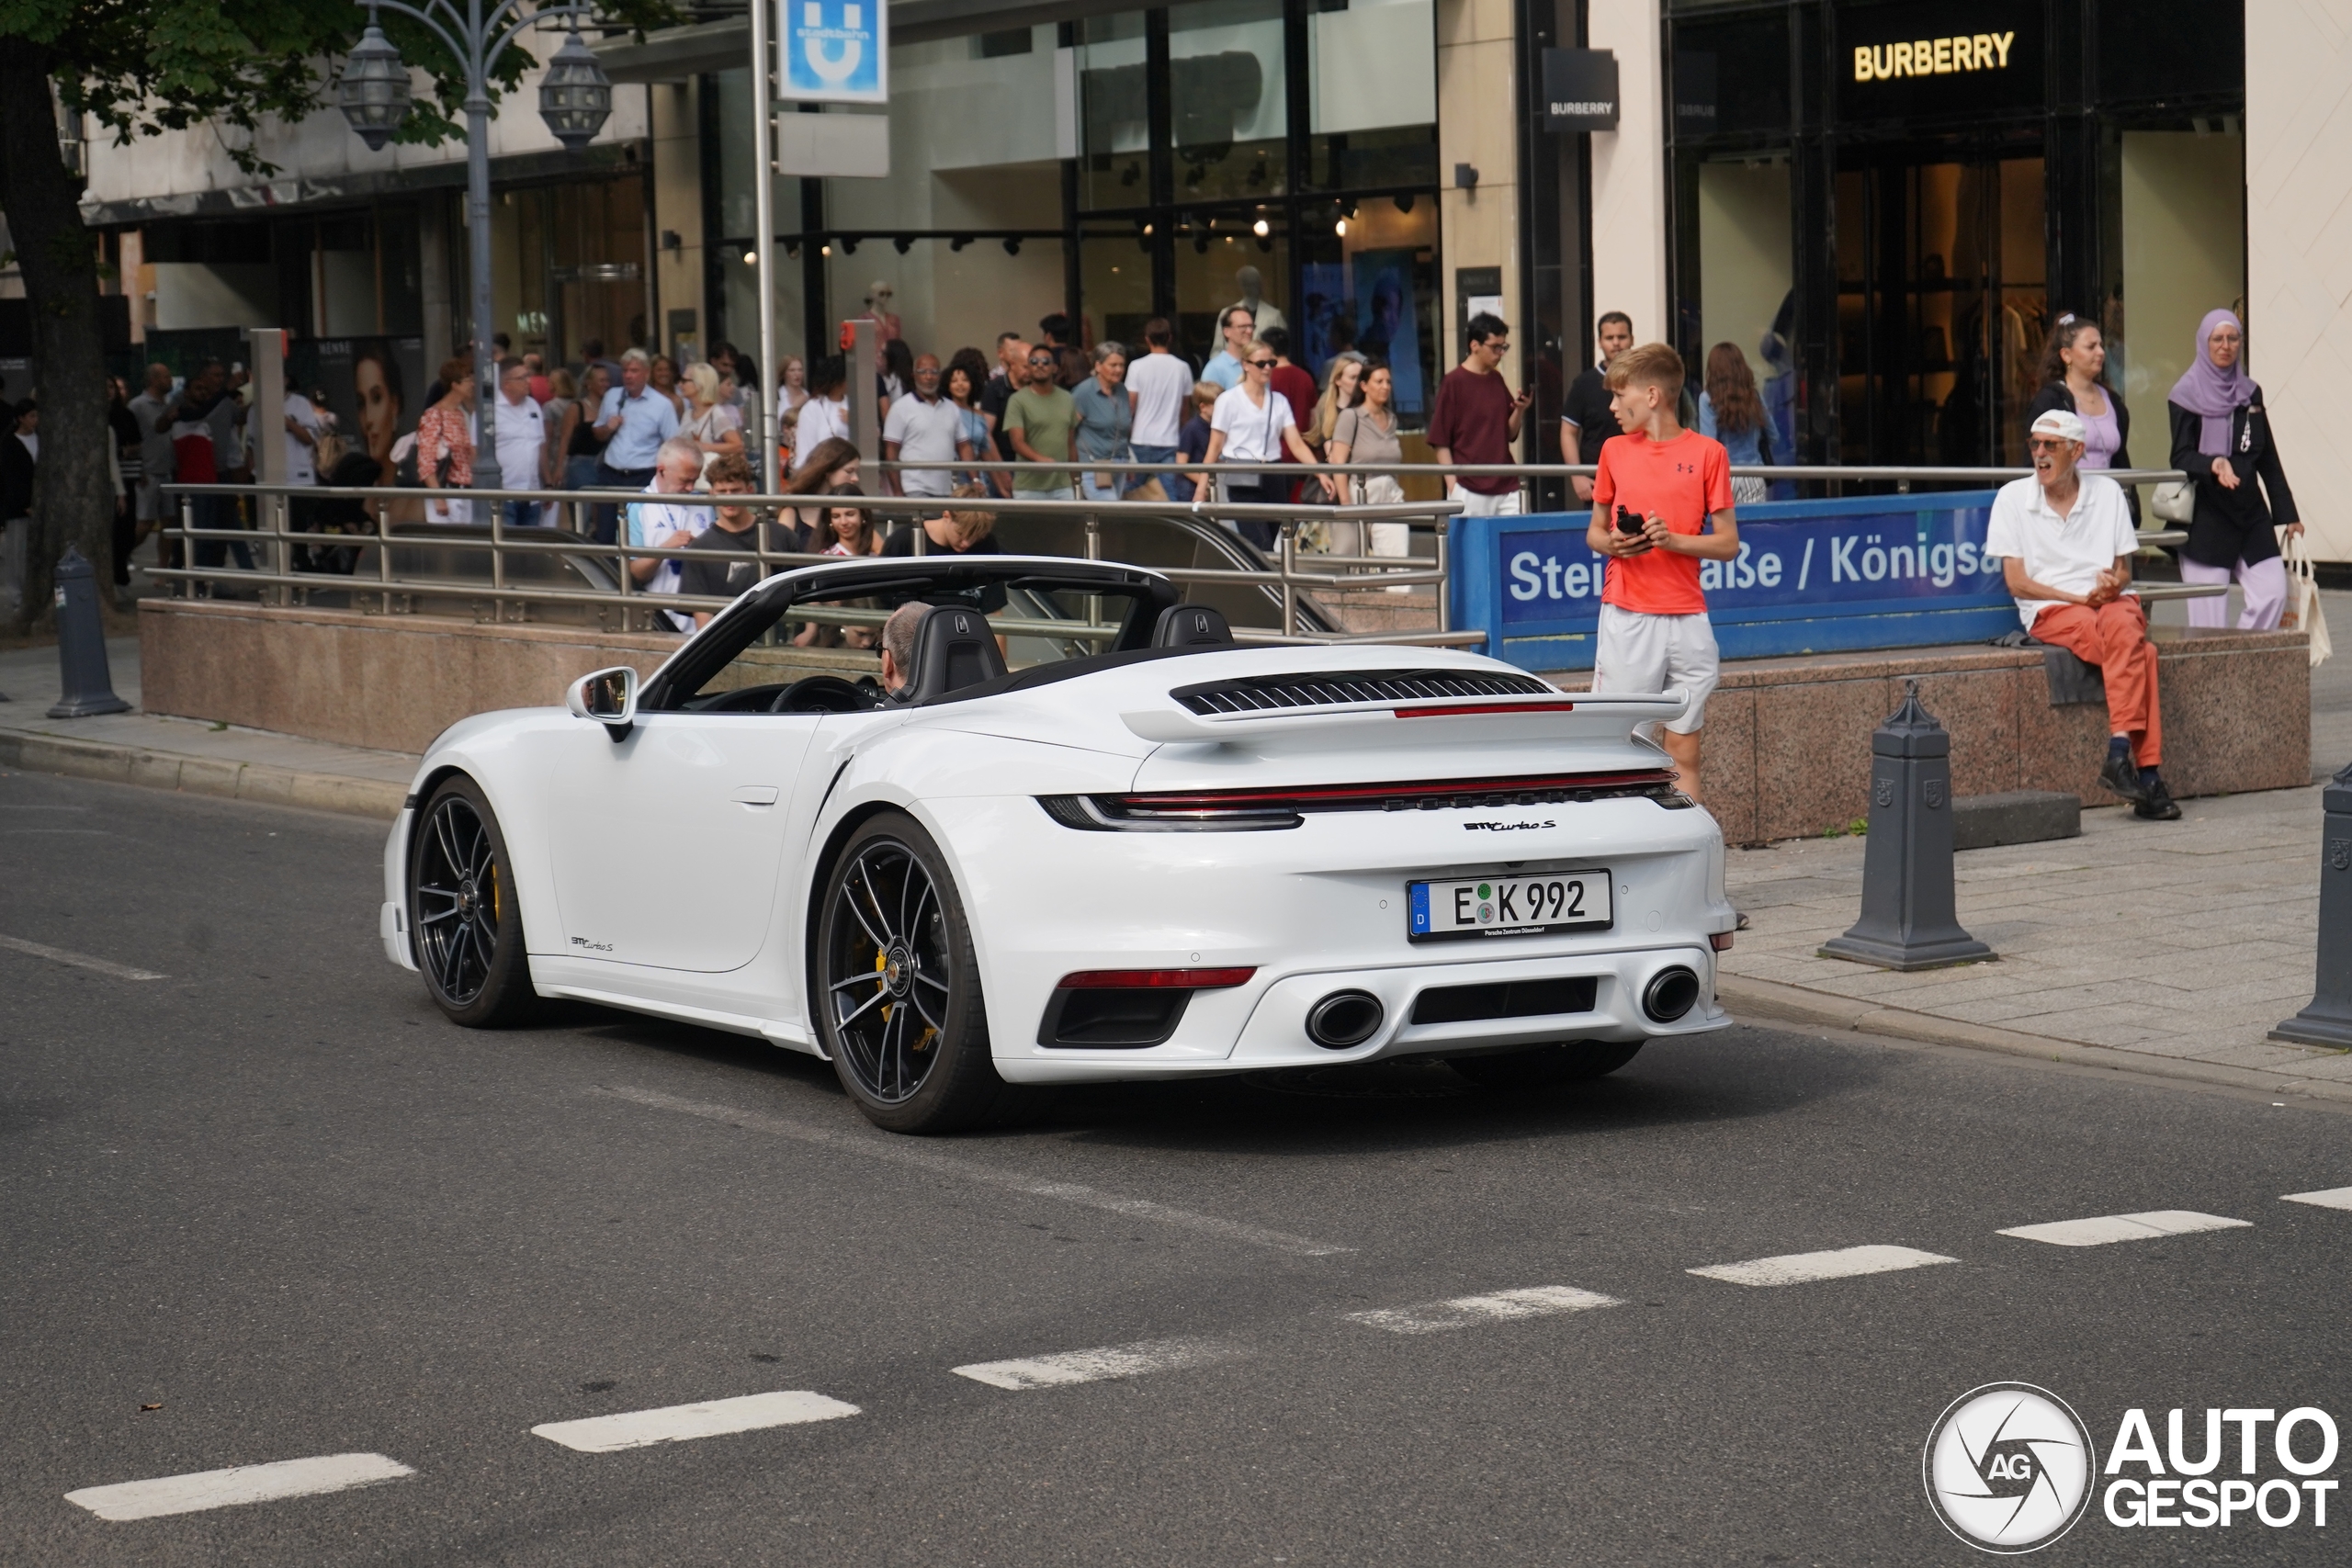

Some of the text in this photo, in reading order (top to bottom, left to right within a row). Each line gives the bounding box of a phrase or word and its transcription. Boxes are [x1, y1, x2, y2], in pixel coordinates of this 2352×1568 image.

[1855, 30, 2015, 83] BURBERRY
[1551, 102, 1613, 116] BURBERRY
[1510, 532, 2002, 602] Steiaße / Königsa
[1490, 820, 1540, 831] turbo
[1541, 820, 1556, 829] S
[1454, 880, 1586, 925] E K 992
[1417, 914, 1425, 925] D
[1521, 926, 1544, 934] Düsseldorf
[582, 940, 606, 951] turbo
[605, 943, 613, 952] S
